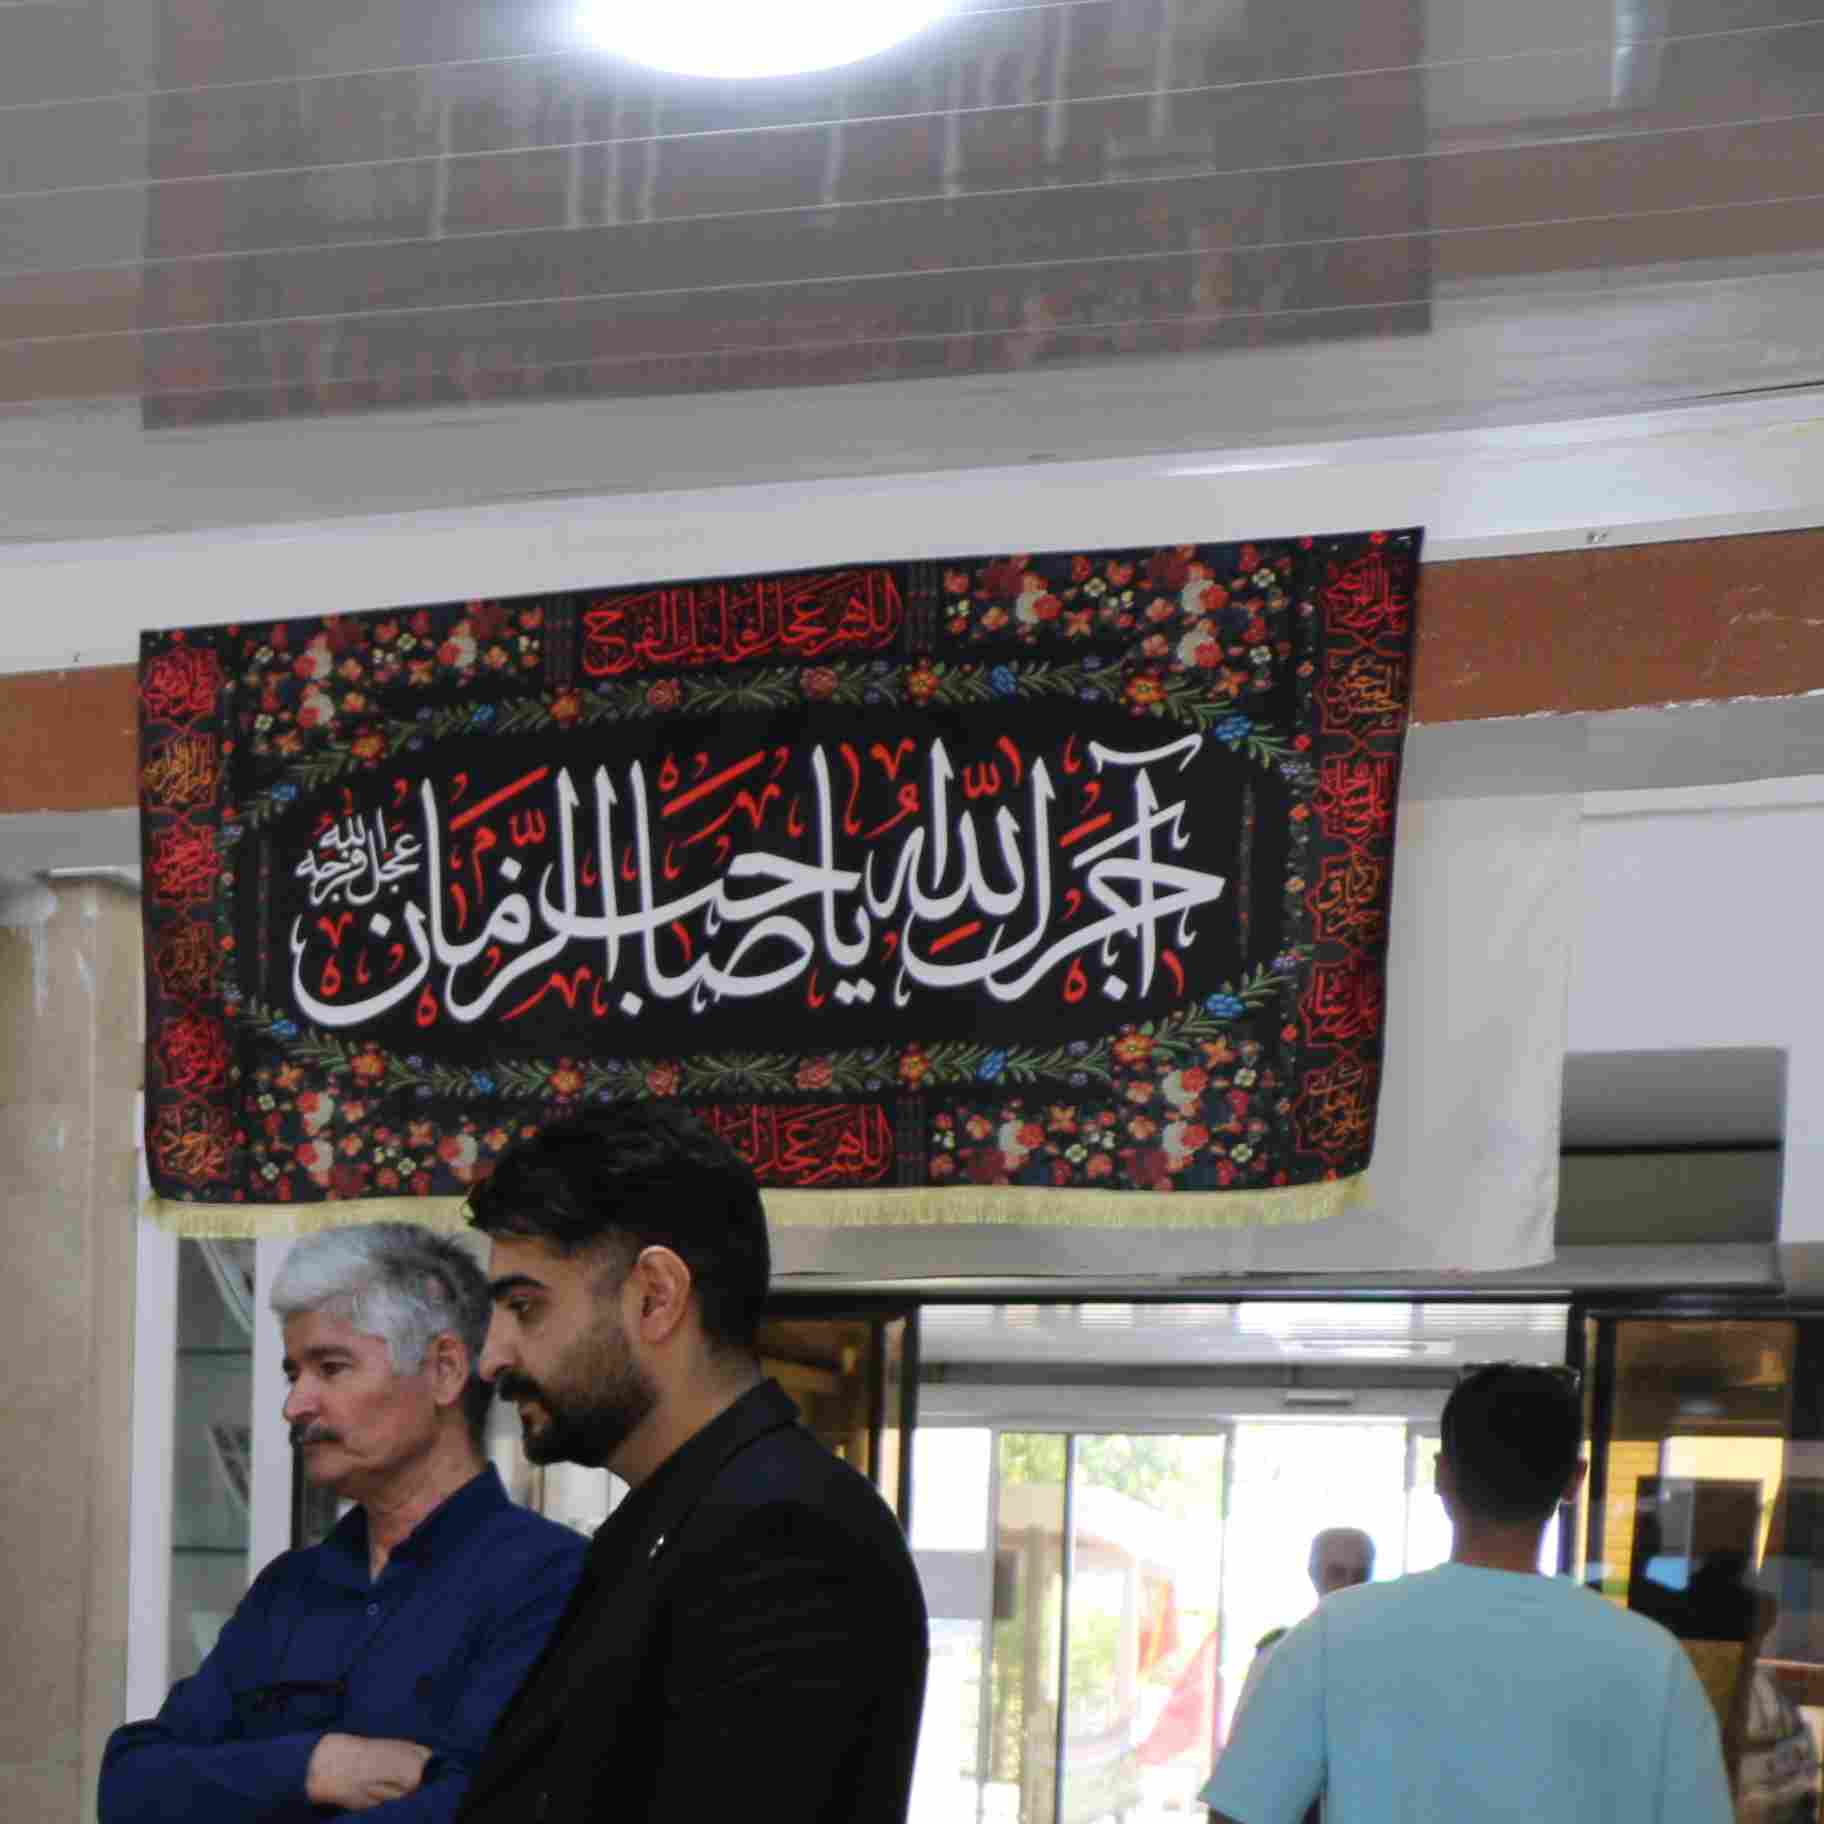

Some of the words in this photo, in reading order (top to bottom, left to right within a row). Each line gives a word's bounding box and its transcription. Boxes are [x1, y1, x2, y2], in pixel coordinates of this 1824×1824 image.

[290, 764, 620, 1027] الزمان
[813, 743, 877, 1004] یا
[864, 737, 1024, 920] الله
